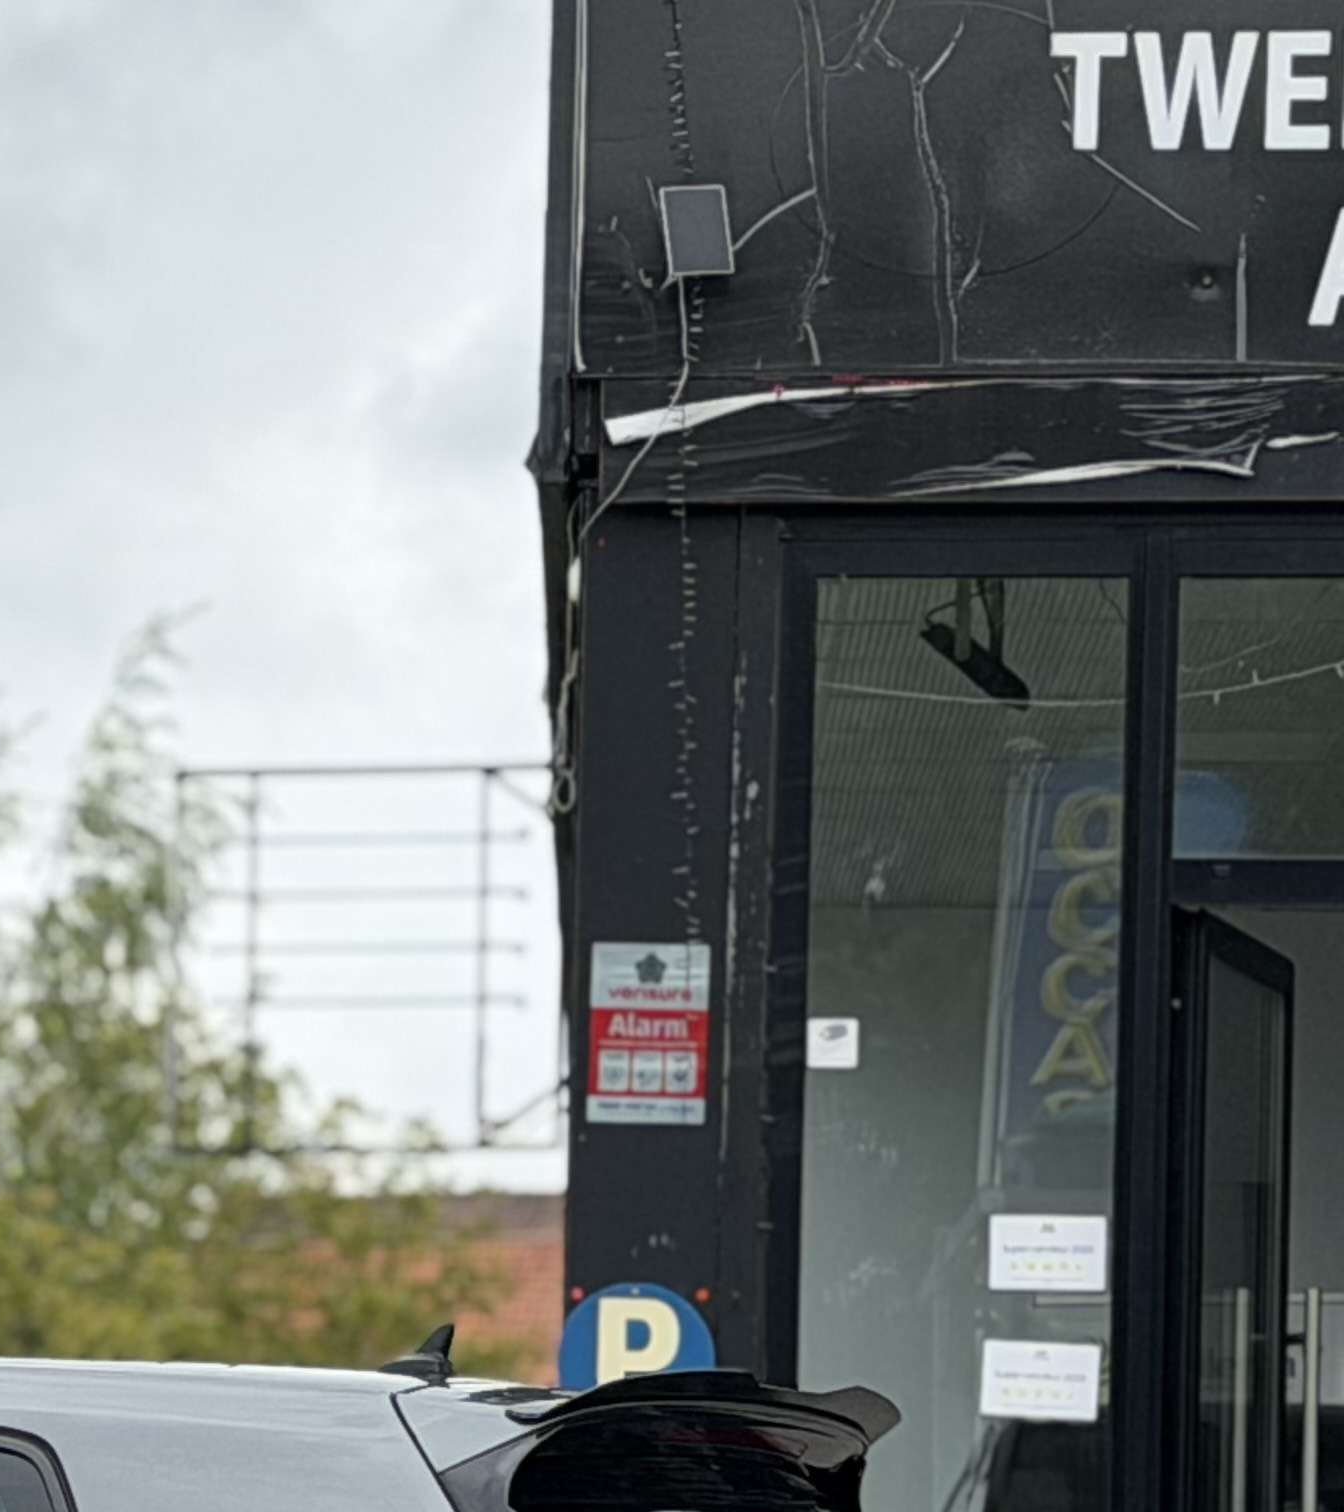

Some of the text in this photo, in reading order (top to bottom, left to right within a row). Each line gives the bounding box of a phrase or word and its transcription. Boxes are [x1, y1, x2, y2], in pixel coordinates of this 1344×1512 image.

[1050, 30, 1344, 150] TWE
[1029, 786, 1123, 1116] OCCA
[608, 1013, 689, 1040] Alarm
[596, 1297, 680, 1386] P
